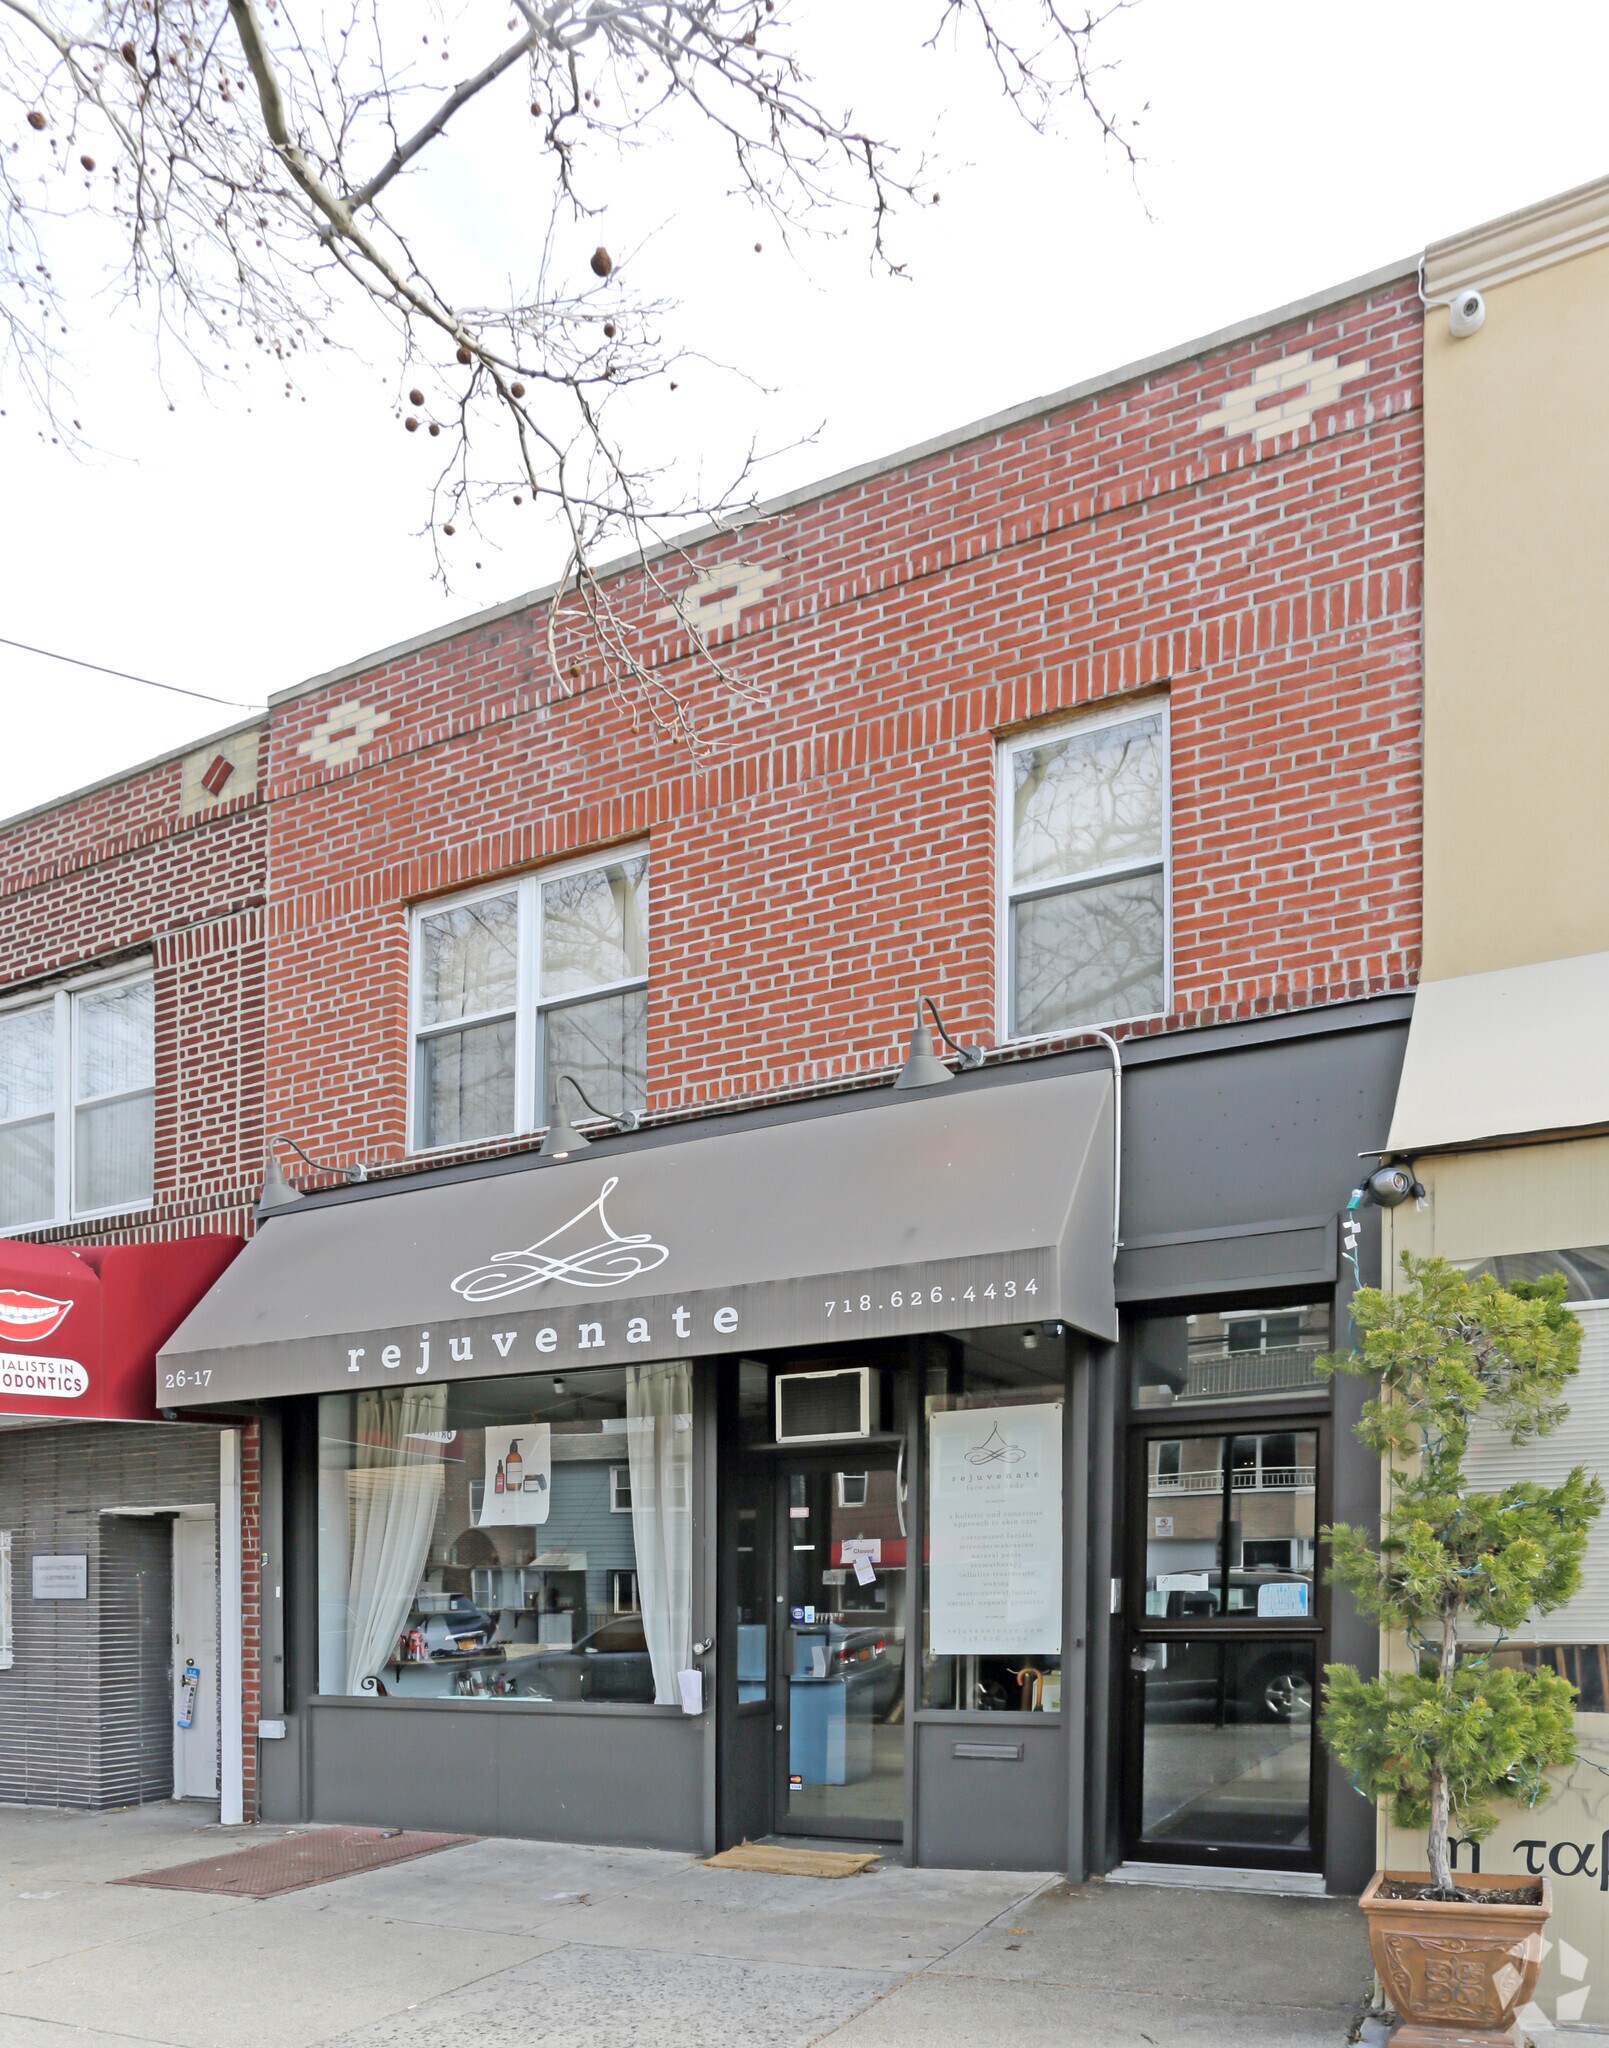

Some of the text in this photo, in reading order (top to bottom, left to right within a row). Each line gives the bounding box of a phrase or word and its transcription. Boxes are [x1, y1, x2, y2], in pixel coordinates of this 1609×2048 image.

[825, 1278, 1039, 1318] 718.626.4434
[347, 1306, 740, 1375] rejuvenate
[59, 1363, 74, 1375] IN
[2, 1373, 82, 1392] ODONTICS
[165, 1369, 213, 1389] 26-17
[951, 1470, 1040, 1483] rejuvenate
[955, 1511, 985, 1519] holistic
[953, 1519, 989, 1528] approach
